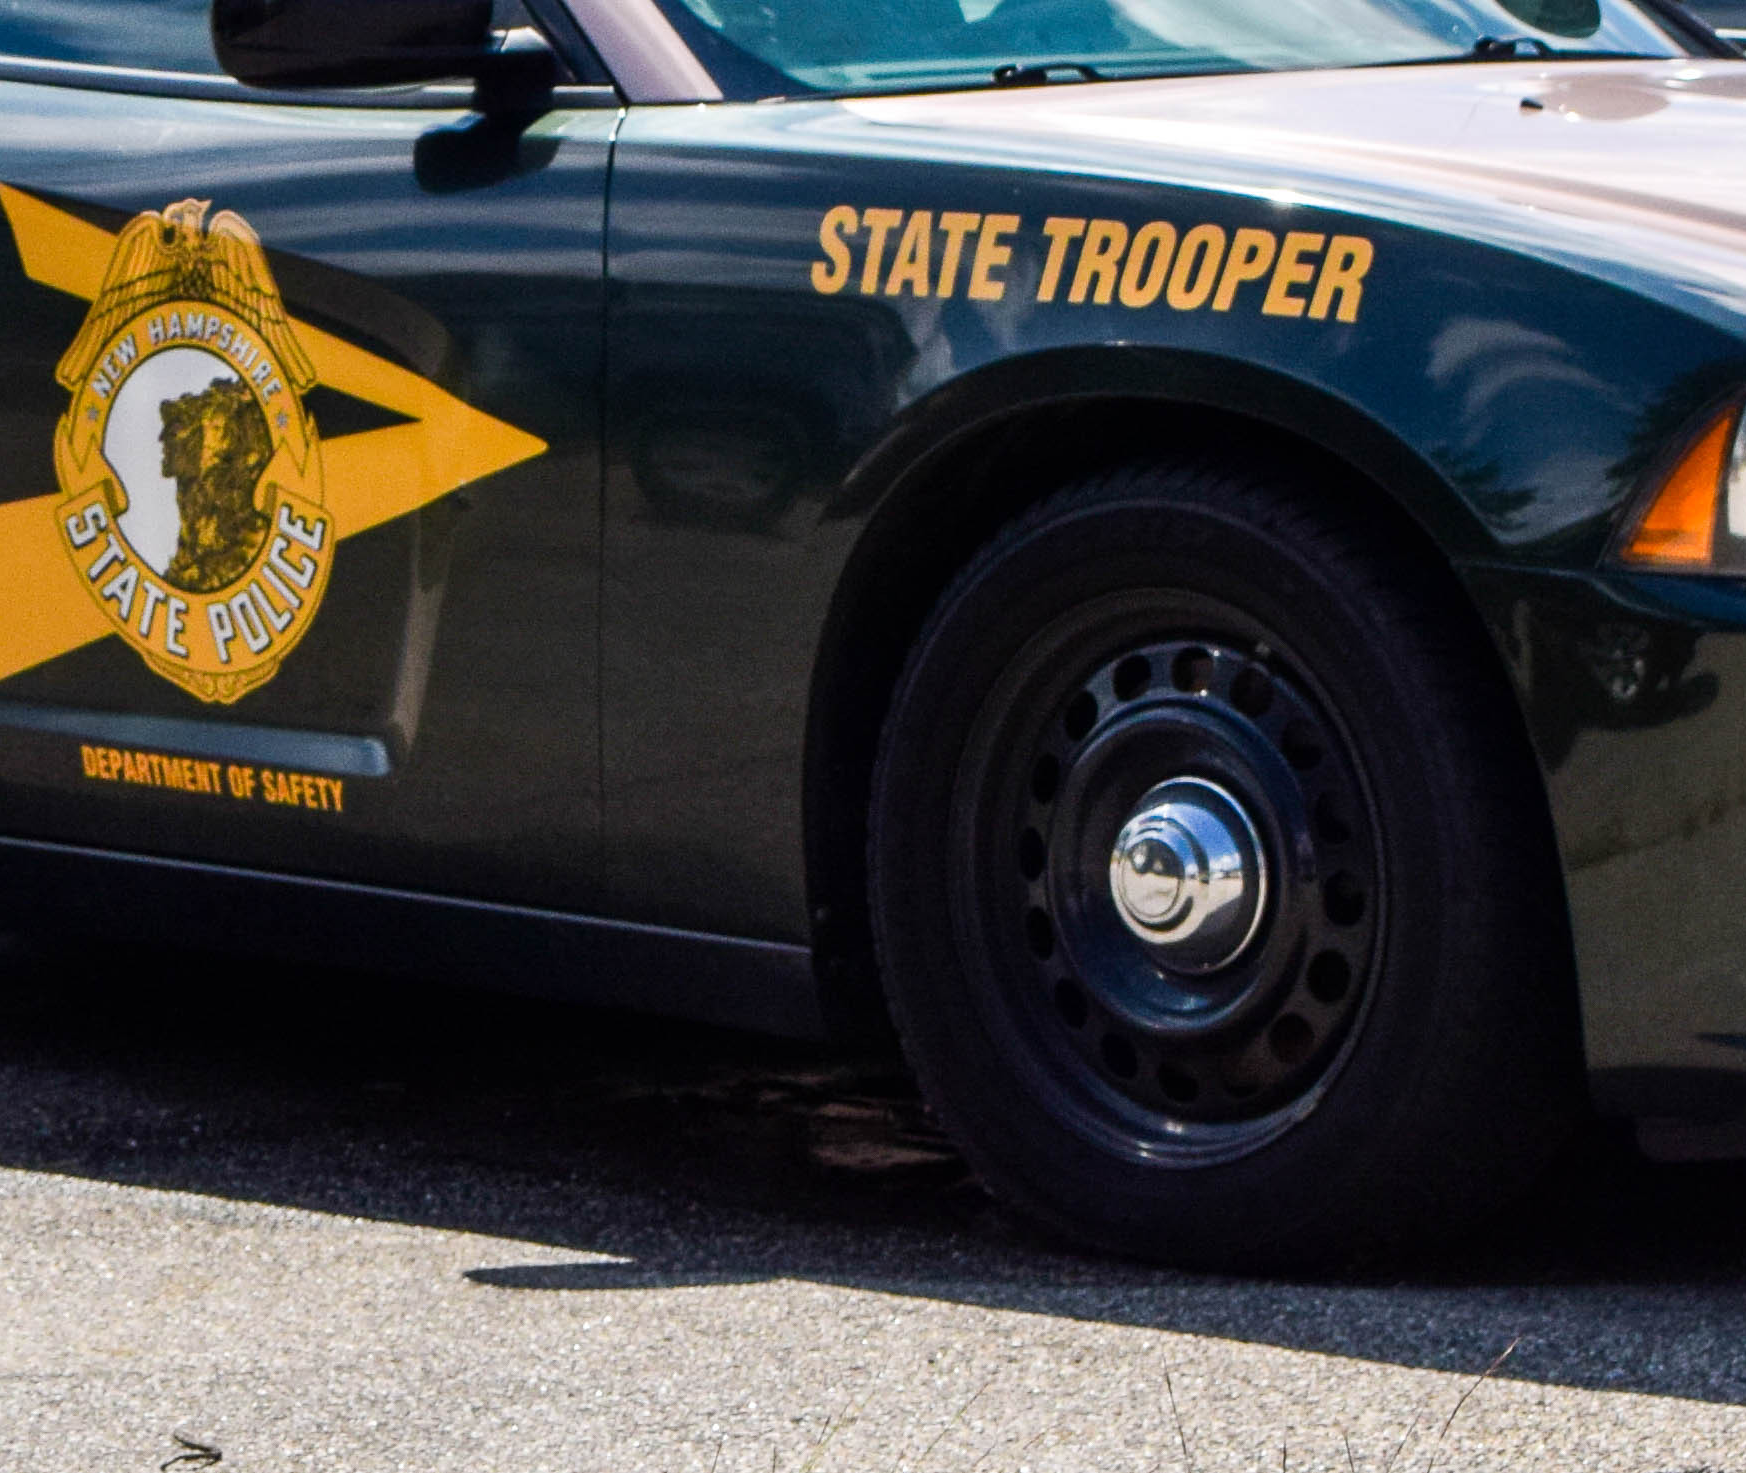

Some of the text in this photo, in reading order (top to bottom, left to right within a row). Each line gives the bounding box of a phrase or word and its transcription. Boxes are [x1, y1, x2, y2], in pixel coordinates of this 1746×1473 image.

[811, 204, 1374, 324] STATE TROOPER
[91, 311, 283, 405] NEW HAMPSHIRE
[66, 502, 327, 665] STATE POLICE
[80, 744, 343, 813] DEPARTMENT OF SAFETY
